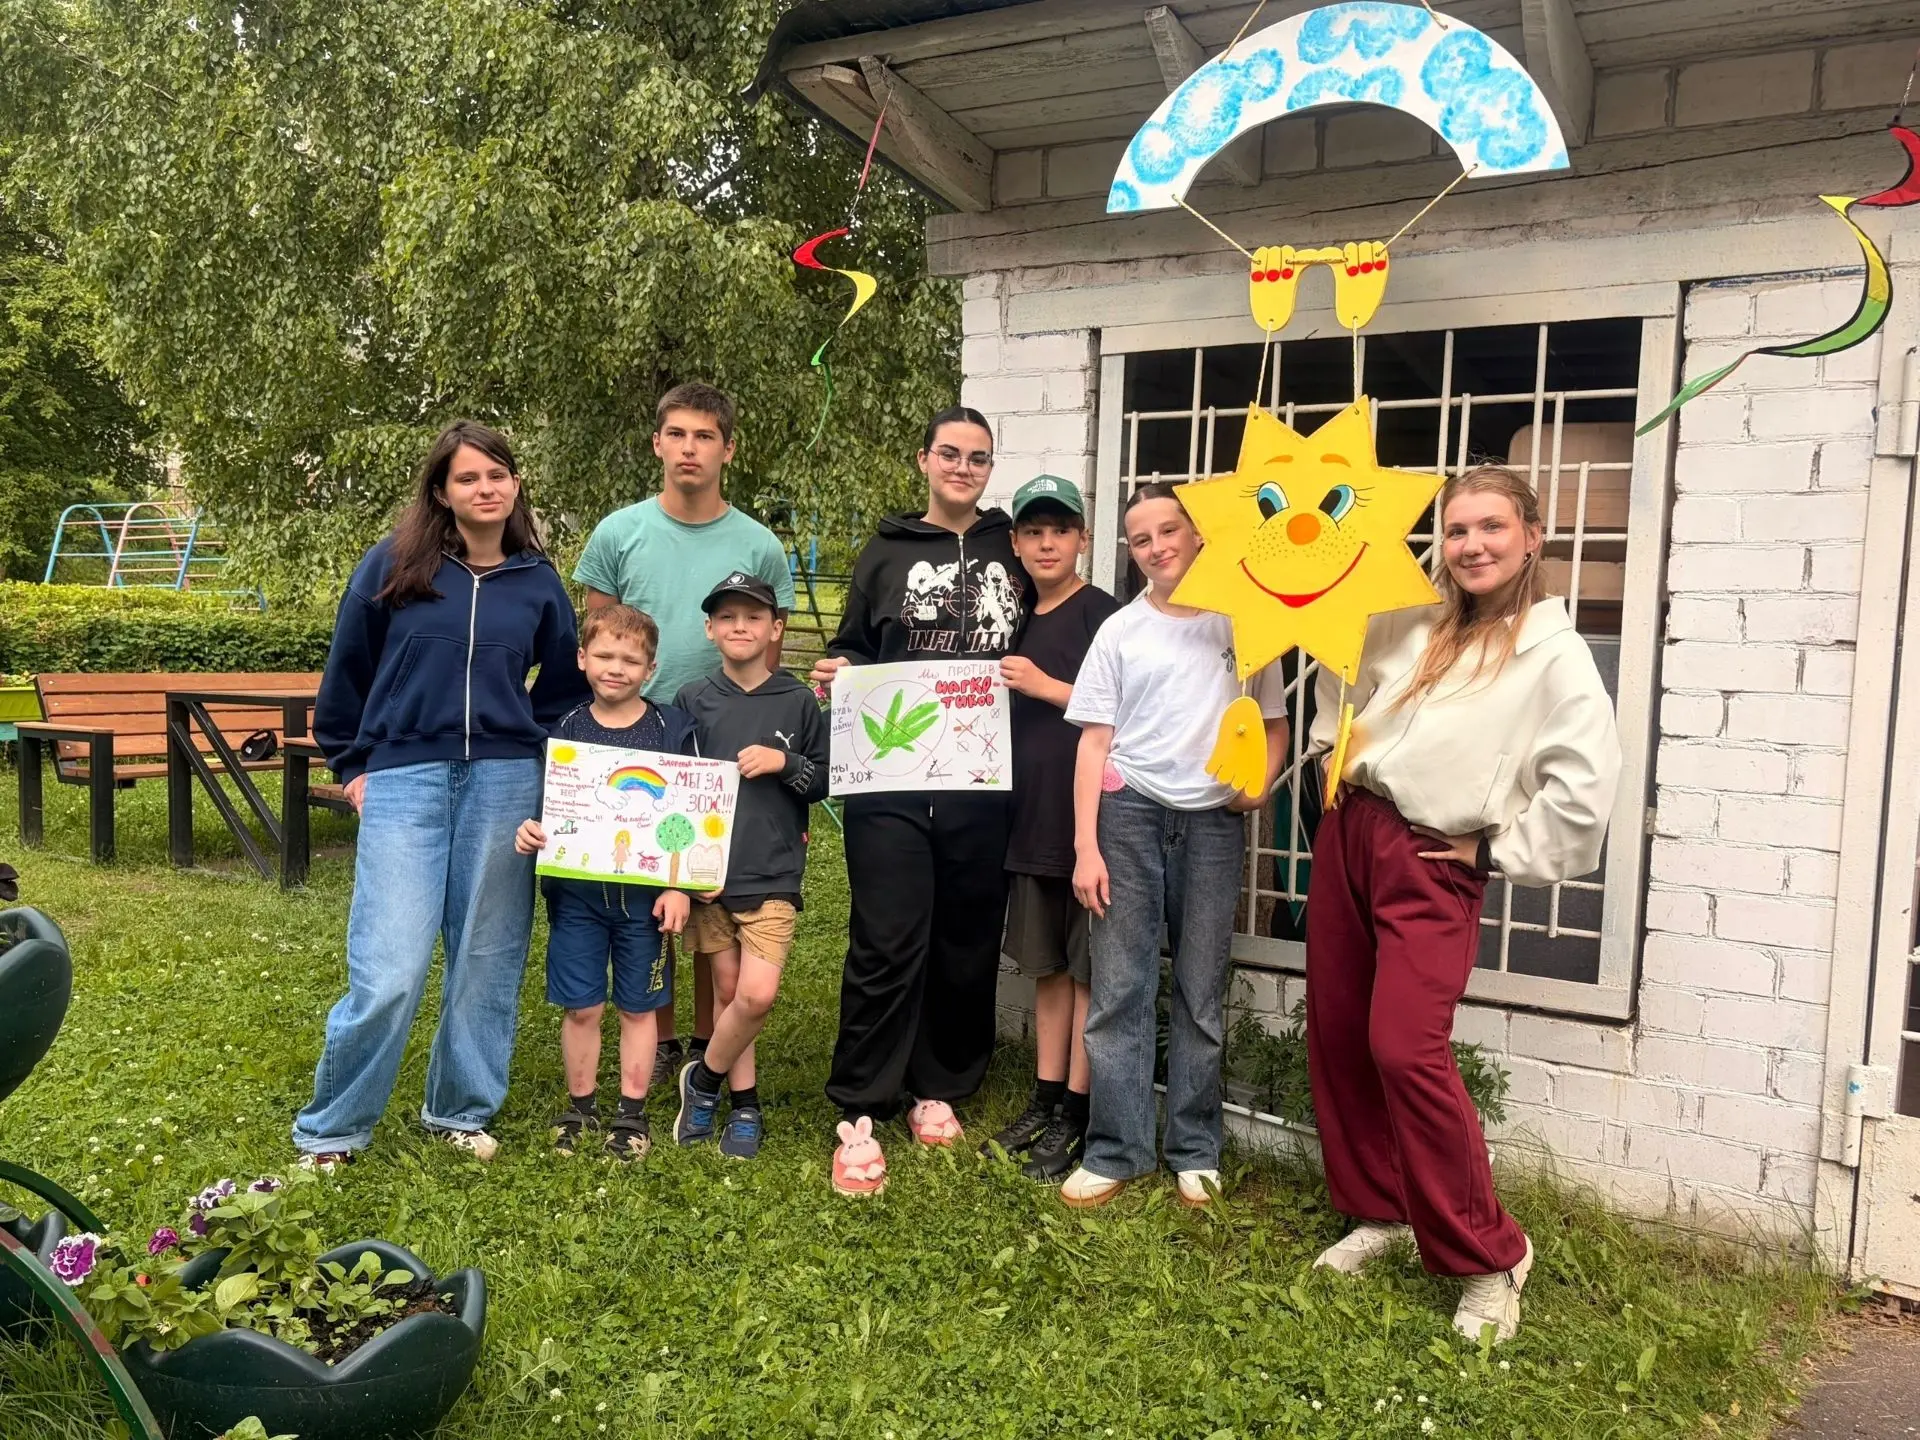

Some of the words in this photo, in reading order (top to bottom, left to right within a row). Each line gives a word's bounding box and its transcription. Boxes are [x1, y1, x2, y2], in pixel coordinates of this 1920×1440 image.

[948, 664, 995, 677] ПРОТИВ
[941, 693, 995, 709] ТИКОВ
[832, 707, 852, 716] БУДЬ
[831, 763, 849, 774] МЫ
[673, 770, 701, 790] МЫ
[704, 772, 725, 793] ЗА
[831, 774, 843, 786] ЗА
[848, 770, 874, 785] ЗОЖ
[560, 788, 577, 799] НЕТ
[685, 793, 734, 814] ЗОЖ!!!
